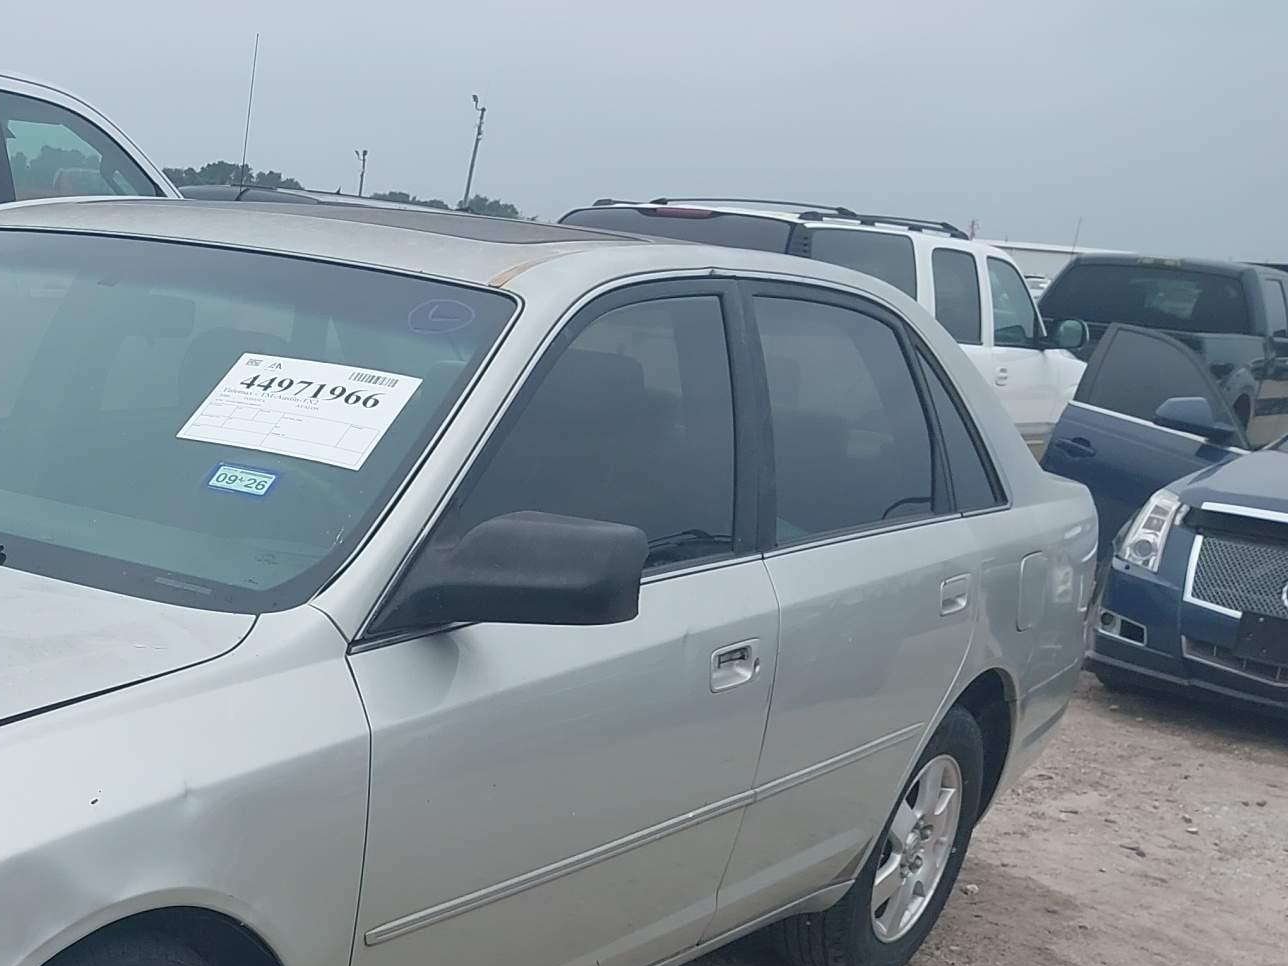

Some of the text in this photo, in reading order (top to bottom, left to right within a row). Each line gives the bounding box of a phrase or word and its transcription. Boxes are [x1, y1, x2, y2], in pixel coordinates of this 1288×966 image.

[239, 373, 386, 410] 44971966
[215, 472, 268, 491] 09 26
